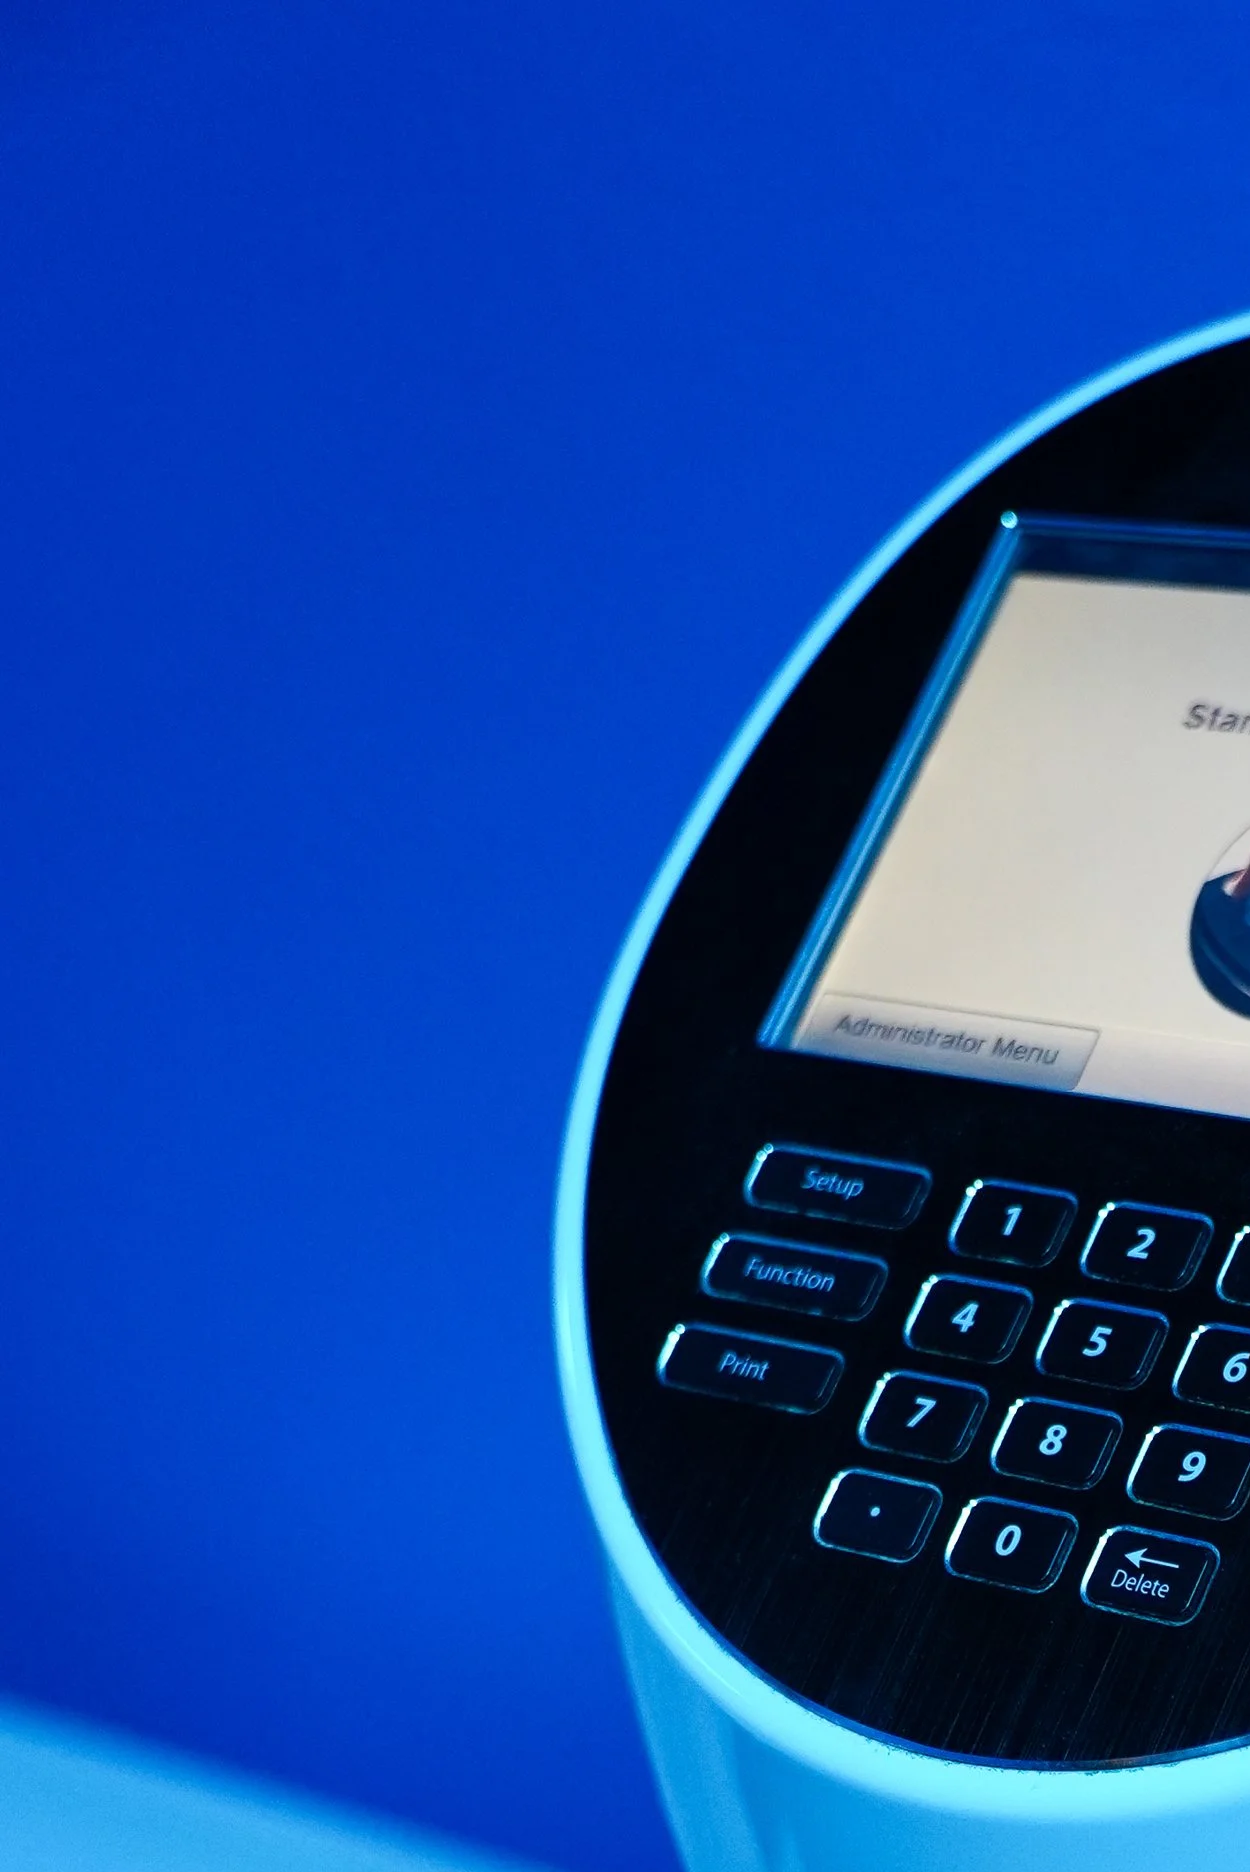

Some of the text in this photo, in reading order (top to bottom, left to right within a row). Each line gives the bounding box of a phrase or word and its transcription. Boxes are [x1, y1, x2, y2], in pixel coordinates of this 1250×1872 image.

[834, 1014, 1060, 1066] Administrator Menu
[802, 1168, 865, 1200] Setup
[1003, 1206, 1022, 1236] 1
[1126, 1228, 1156, 1260] 2
[743, 1256, 836, 1292] Function
[951, 1302, 981, 1333] 4
[1082, 1326, 1112, 1358] 5
[717, 1352, 770, 1380] Print
[1222, 1352, 1250, 1384] 6
[906, 1398, 936, 1429] 7
[1038, 1424, 1068, 1456] 8
[1177, 1451, 1207, 1483] 9
[995, 1525, 1021, 1557] 0
[1110, 1569, 1170, 1599] Delete
